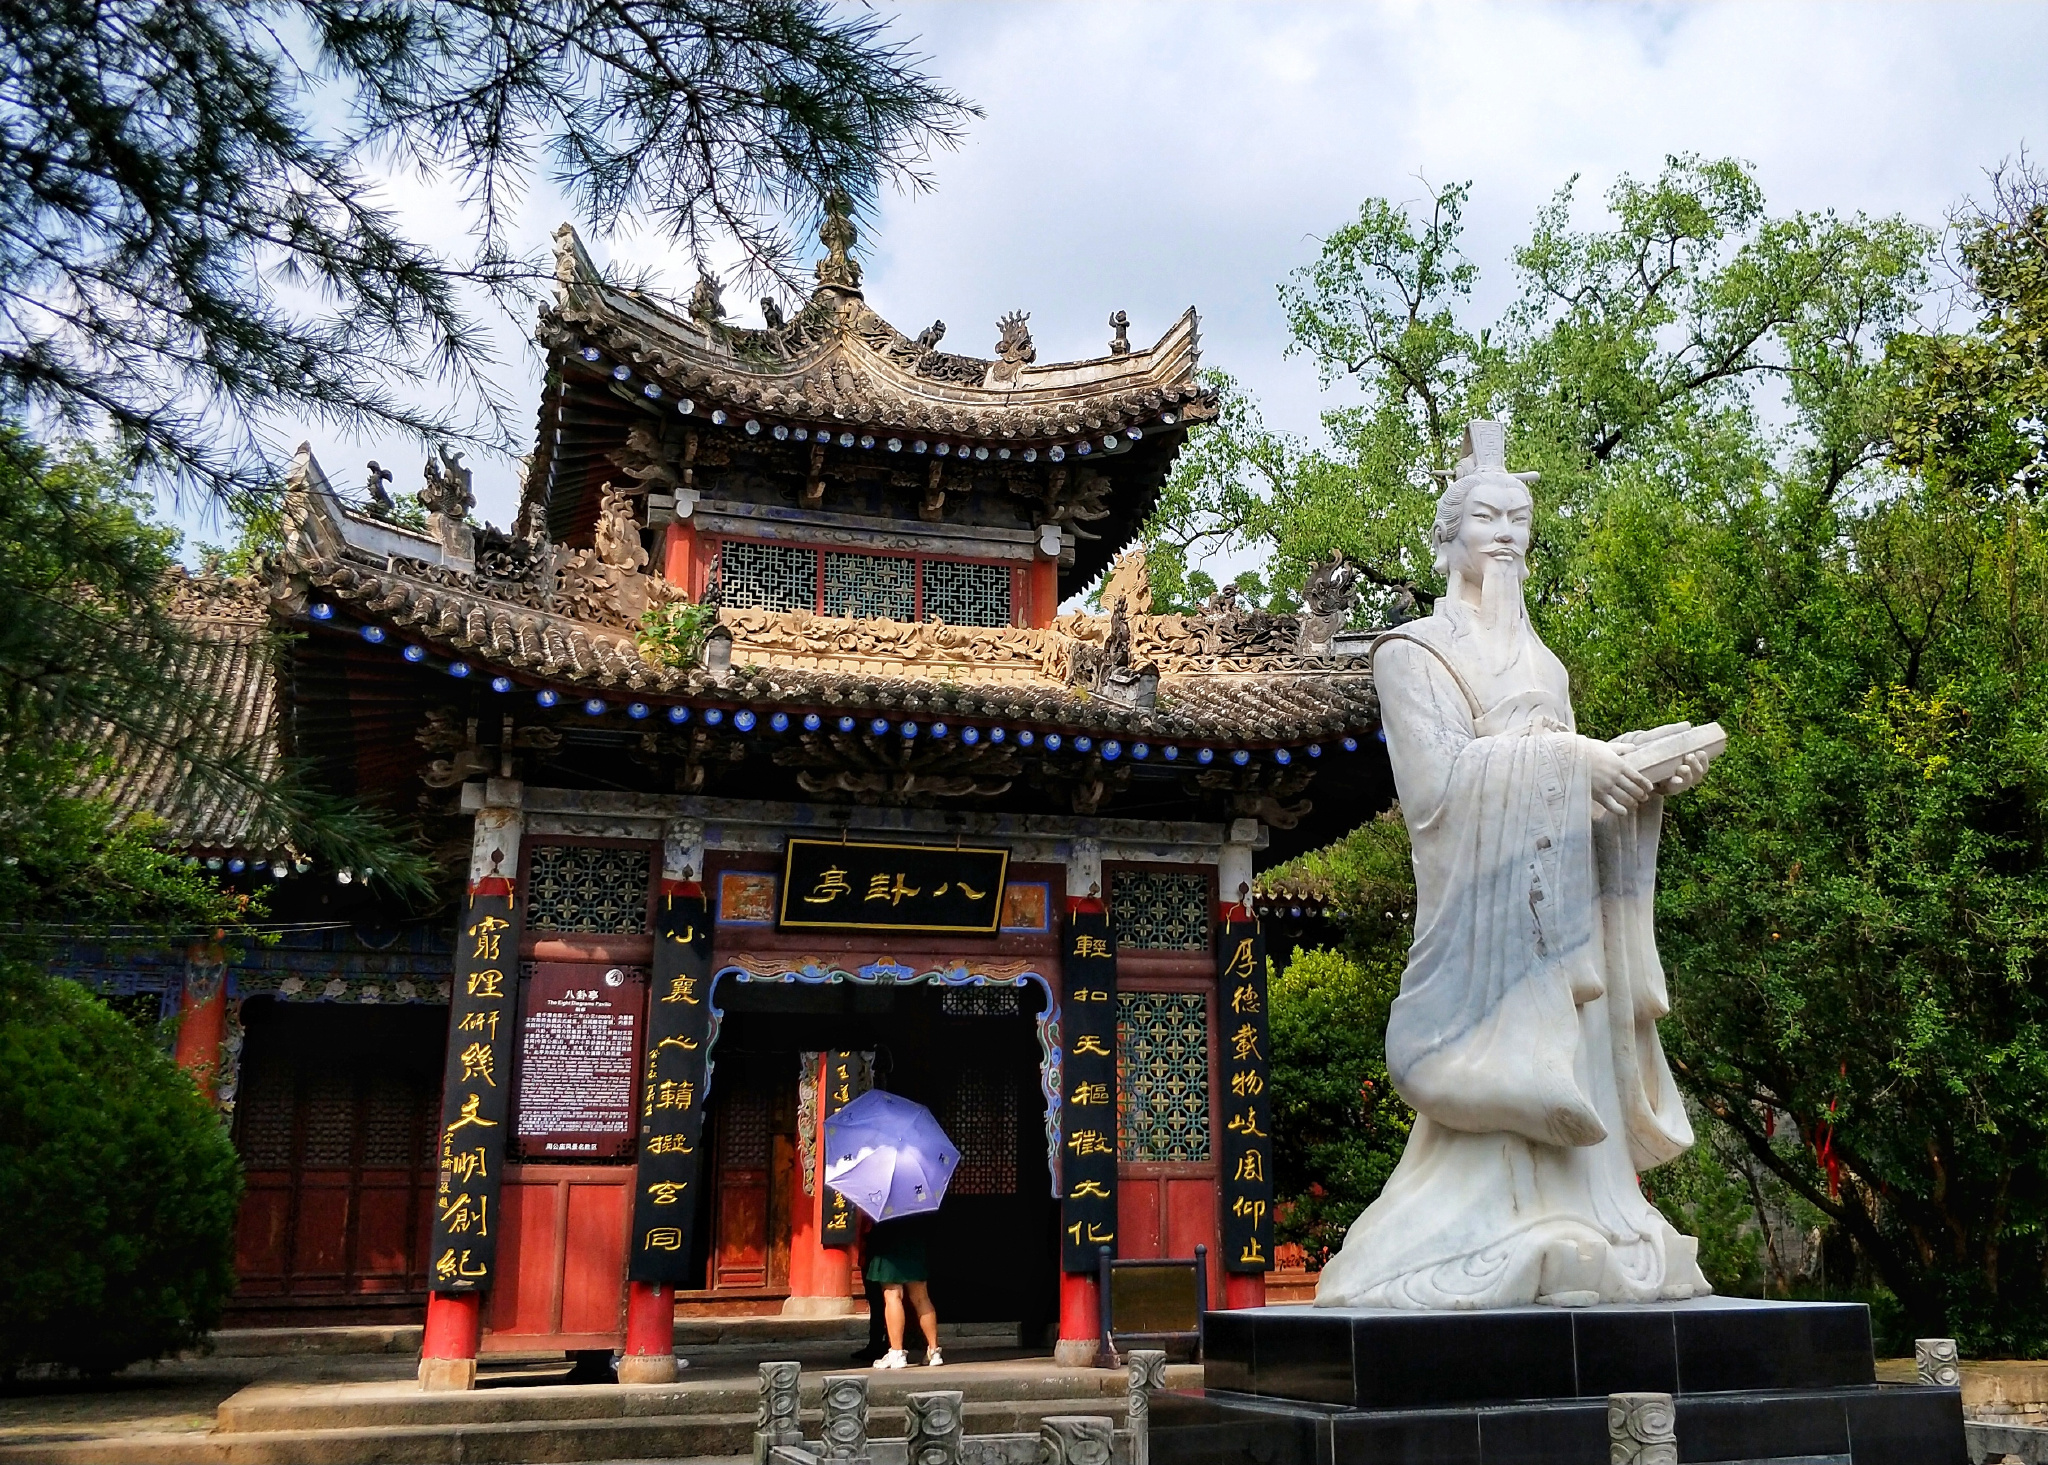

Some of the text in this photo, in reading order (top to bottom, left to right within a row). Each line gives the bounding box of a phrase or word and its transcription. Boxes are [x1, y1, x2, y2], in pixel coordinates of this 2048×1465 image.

[803, 864, 986, 907] 八卦亭
[565, 990, 599, 1000] 八卦亭
